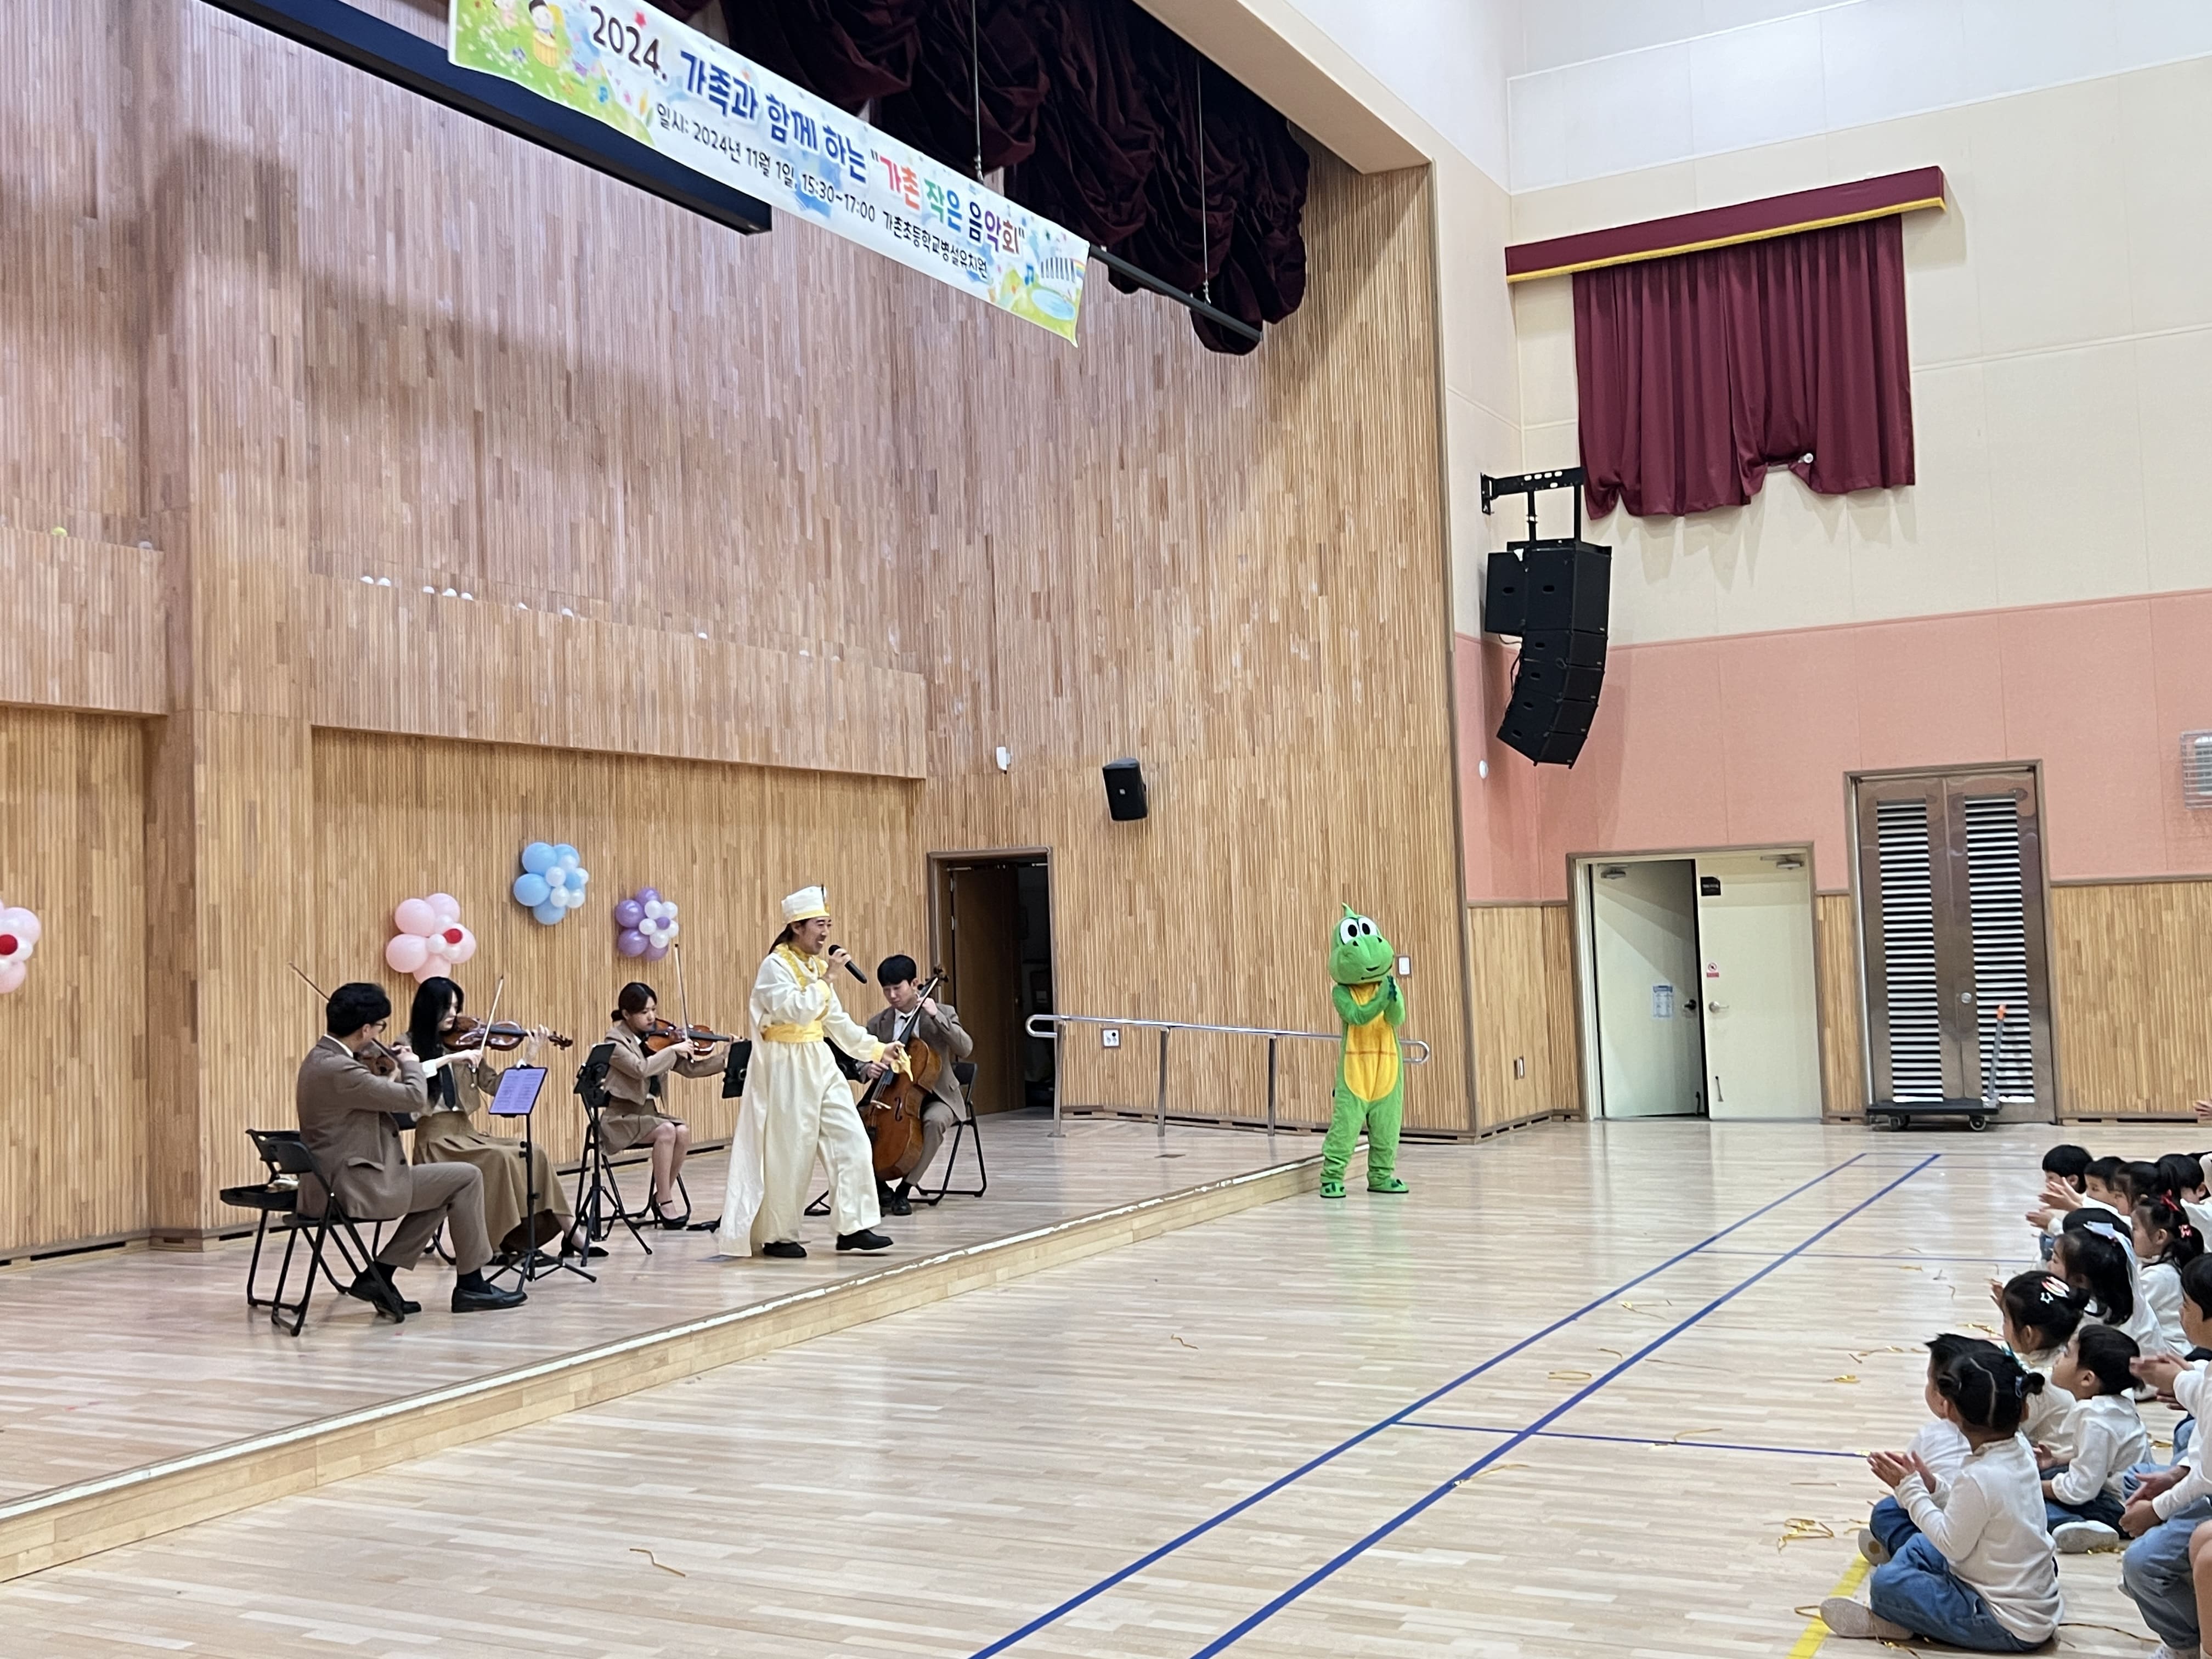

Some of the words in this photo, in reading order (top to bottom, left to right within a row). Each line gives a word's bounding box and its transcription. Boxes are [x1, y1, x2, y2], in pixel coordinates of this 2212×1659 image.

[590, 5, 667, 82] 2024.
[680, 50, 759, 120] 가족과
[766, 93, 818, 151] 함께
[823, 125, 866, 184] 하는
[870, 149, 920, 211] "가촌
[924, 178, 962, 233] 작은
[969, 201, 1025, 255] 음악회"
[657, 103, 689, 133] 일시:
[693, 120, 741, 165] 2024년
[746, 147, 771, 178] 11월
[802, 173, 876, 223] 15:30~17:00
[882, 210, 988, 279] 가촌초등학교병설유치원
